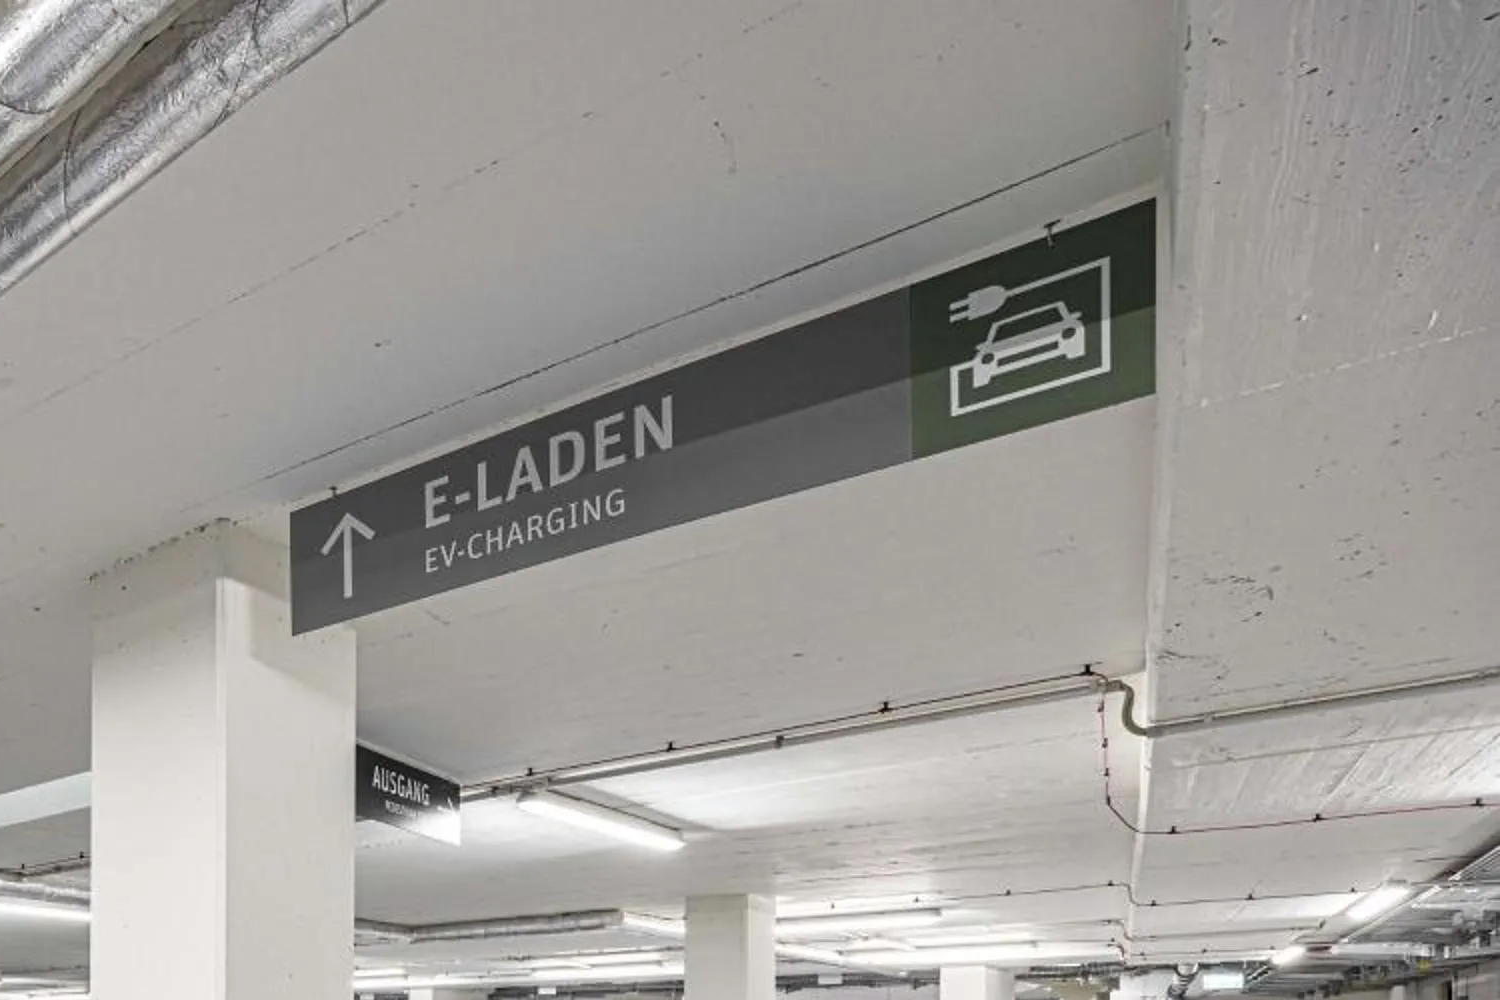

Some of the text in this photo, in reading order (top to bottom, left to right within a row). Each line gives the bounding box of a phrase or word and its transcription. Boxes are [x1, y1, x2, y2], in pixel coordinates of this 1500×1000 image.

[425, 395, 673, 528] E-LADEN
[425, 488, 626, 573] EV-CHARGING
[372, 764, 430, 806] AUSGANG
